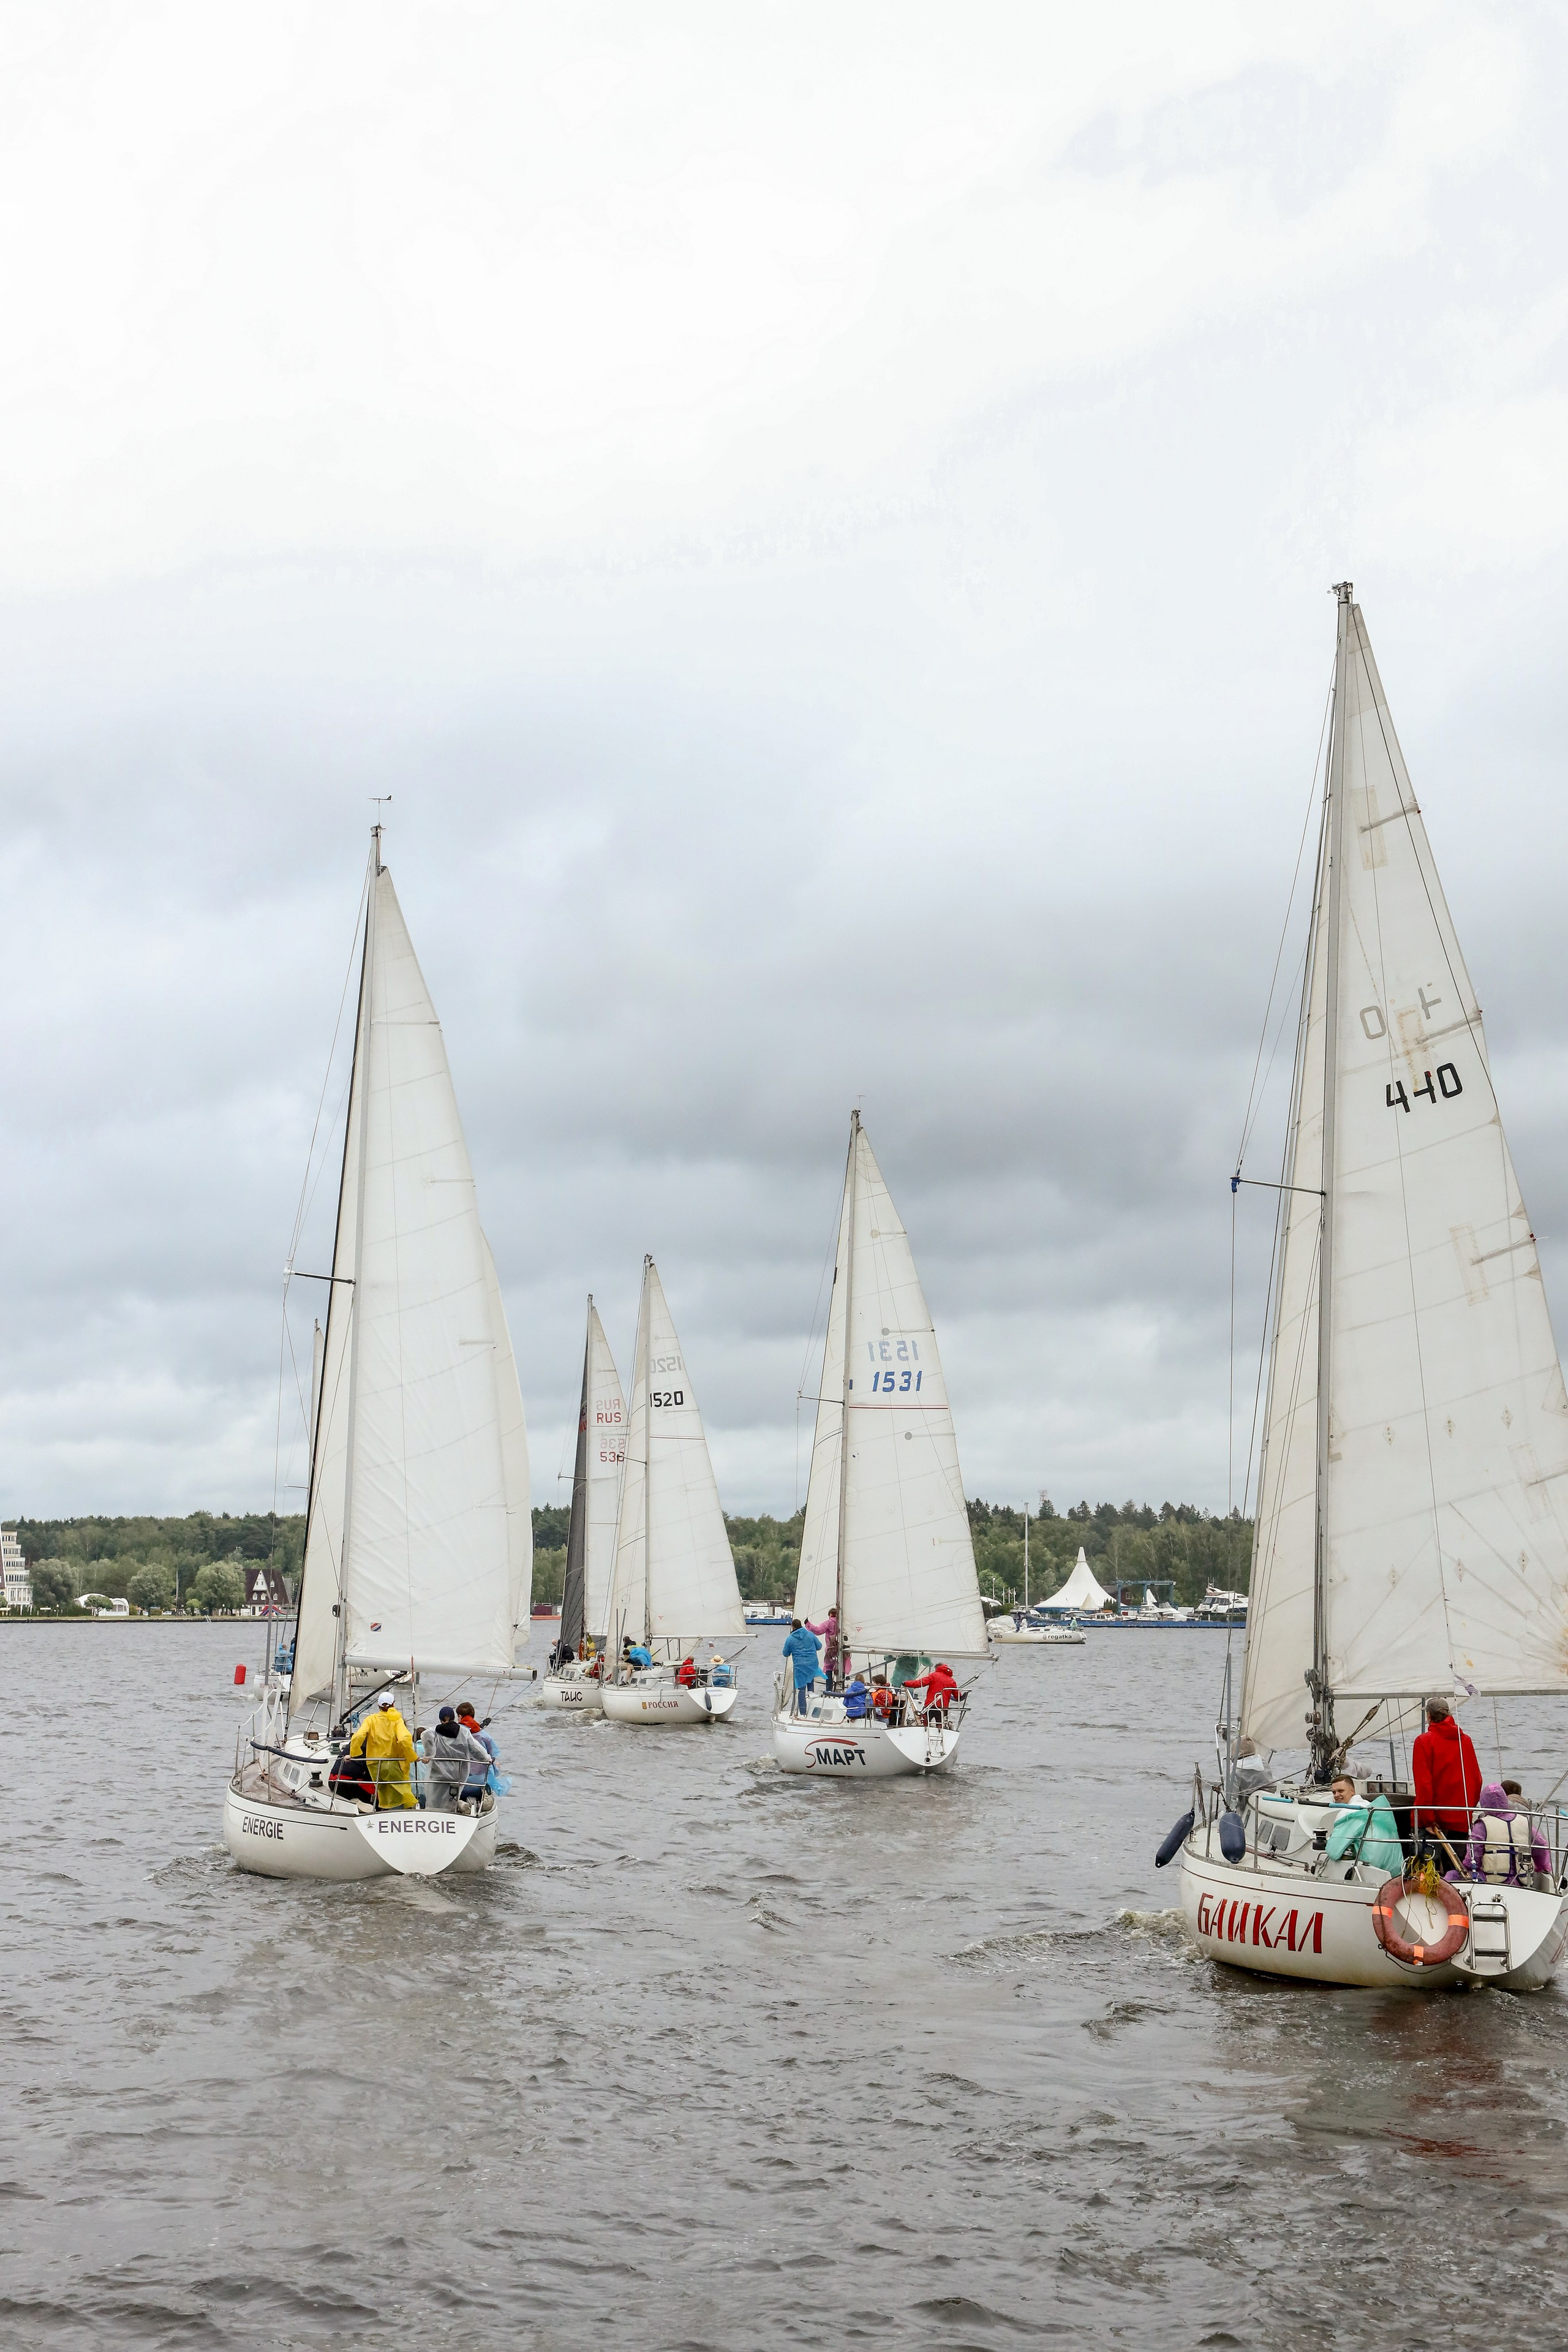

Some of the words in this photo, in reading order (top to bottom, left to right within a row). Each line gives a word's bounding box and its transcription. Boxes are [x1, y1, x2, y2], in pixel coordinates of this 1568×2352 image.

[872, 1370, 922, 1392] 1531
[650, 1391, 684, 1408] 1520
[597, 1412, 622, 1423] RUS
[242, 1817, 284, 1840] ENERGIE
[379, 1821, 456, 1834] ENERGIE
